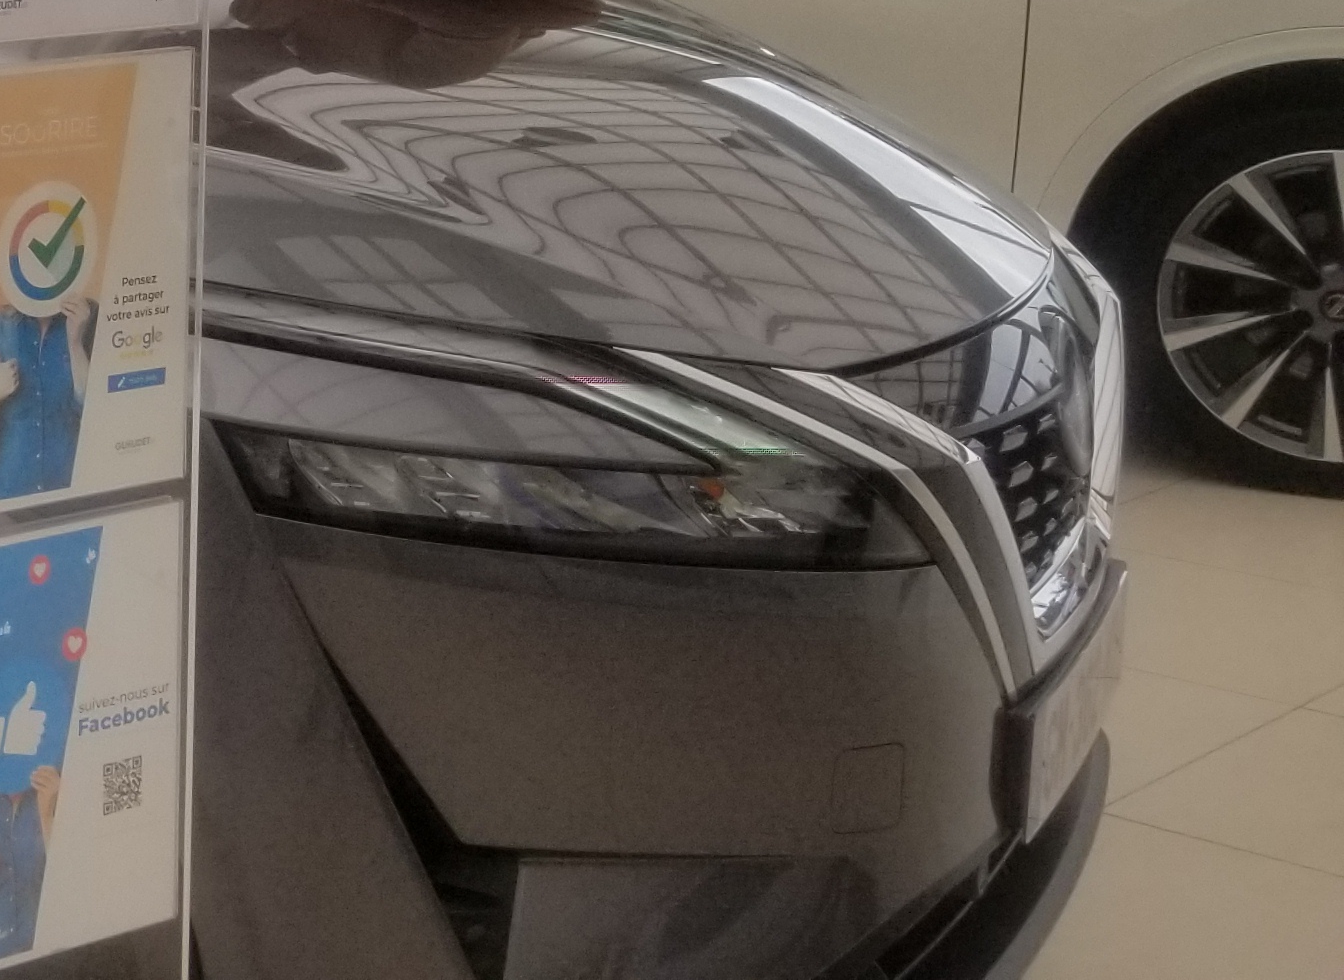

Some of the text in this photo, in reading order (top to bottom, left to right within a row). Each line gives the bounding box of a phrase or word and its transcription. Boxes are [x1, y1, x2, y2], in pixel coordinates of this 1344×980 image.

[121, 274, 157, 287] Pensez
[113, 289, 164, 307] à partager
[106, 304, 170, 322] votre avis sur
[111, 326, 163, 350] Google
[78, 683, 170, 713] suivez-nous sur
[77, 698, 170, 737] Facebook
